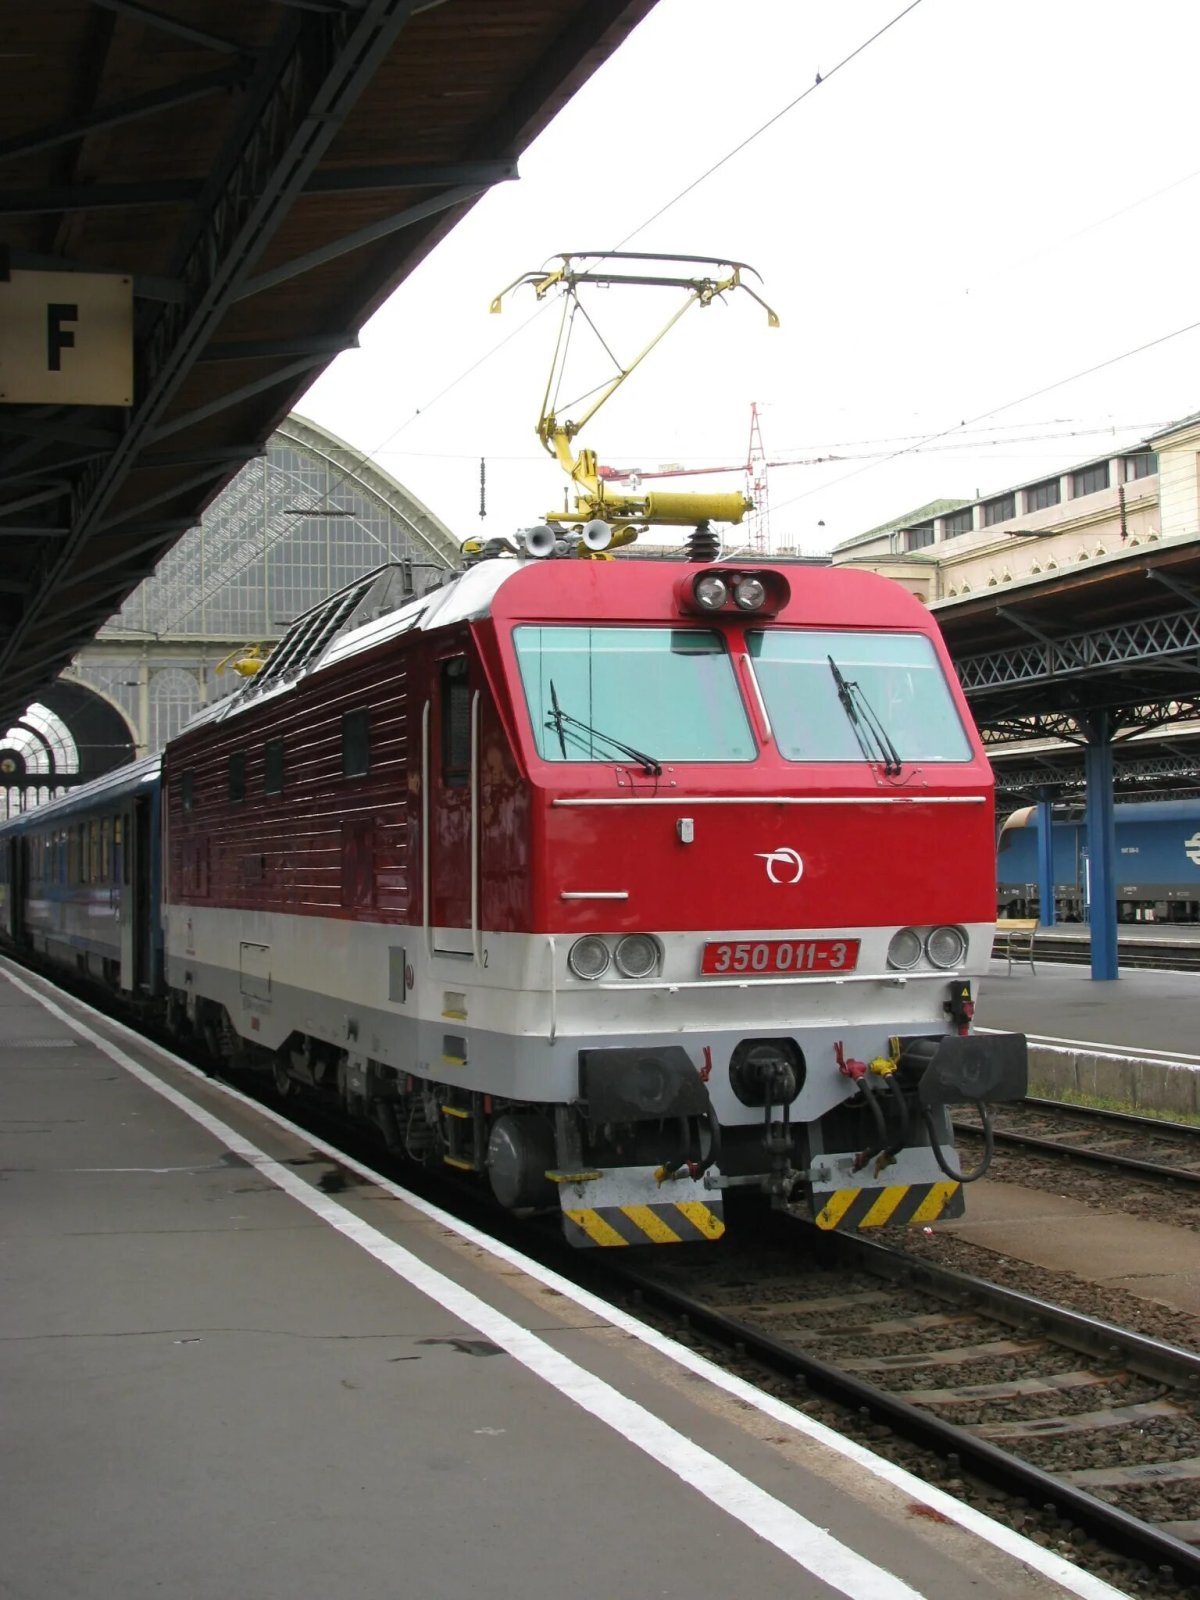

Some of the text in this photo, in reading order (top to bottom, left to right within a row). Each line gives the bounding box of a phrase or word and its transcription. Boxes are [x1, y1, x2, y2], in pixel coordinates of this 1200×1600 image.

[47, 303, 78, 371] F
[483, 949, 489, 968] 2
[714, 943, 847, 971] 350 011-3
